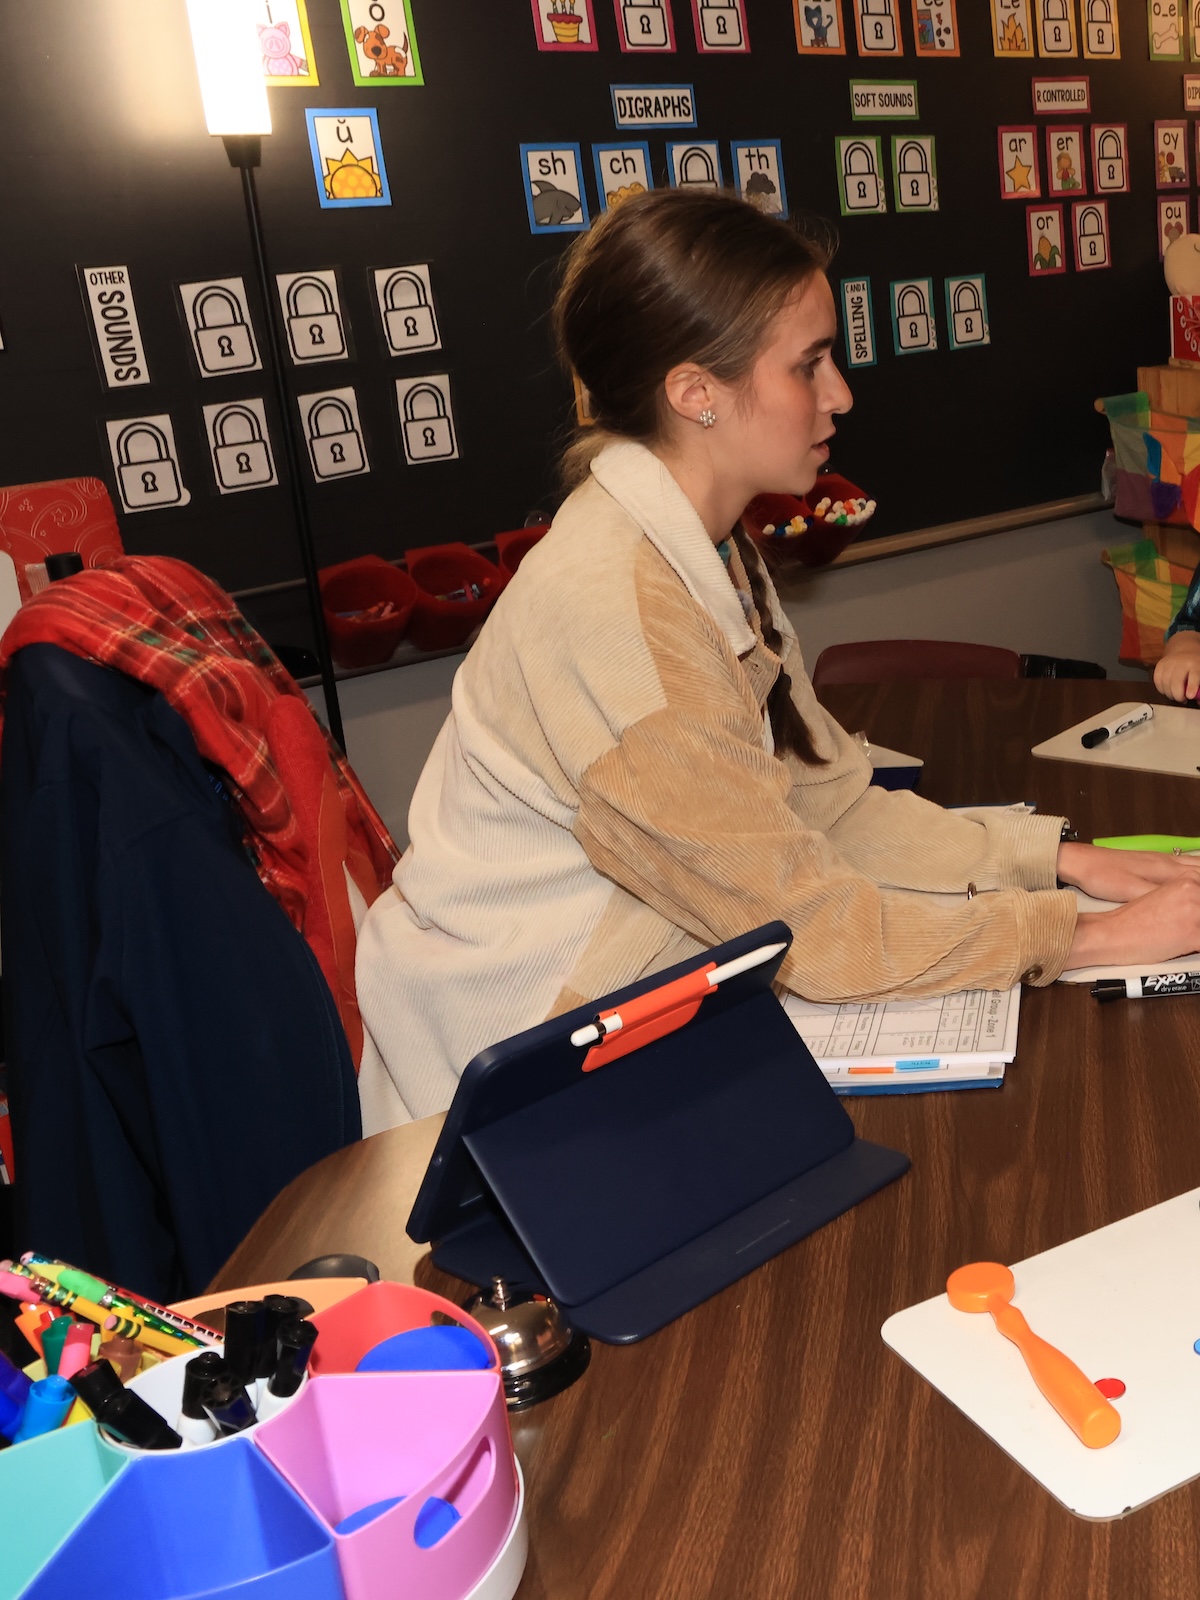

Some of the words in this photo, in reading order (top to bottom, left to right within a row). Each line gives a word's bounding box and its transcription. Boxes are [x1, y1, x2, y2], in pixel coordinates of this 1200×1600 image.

[854, 93, 876, 108] SOFT
[878, 93, 913, 108] SOUNDS
[1036, 89, 1042, 103] R
[1042, 88, 1086, 103] CONTROLLED
[617, 95, 691, 119] DIGRAPHS
[1008, 138, 1027, 152] ar
[1056, 136, 1074, 151] er
[1162, 132, 1179, 150] oy
[538, 151, 567, 175] sh
[609, 151, 636, 175] ch
[744, 148, 770, 170] th
[1165, 206, 1182, 219] ou
[1036, 215, 1054, 231] or
[89, 270, 126, 286] OTHER
[845, 284, 850, 293] C
[850, 284, 861, 293] AND
[850, 296, 868, 359] SPELLING
[97, 290, 142, 382] SOUNDS
[1144, 973, 1187, 991] EXPO
[988, 999, 1001, 1015] Group
[986, 1019, 999, 1033] Zone
